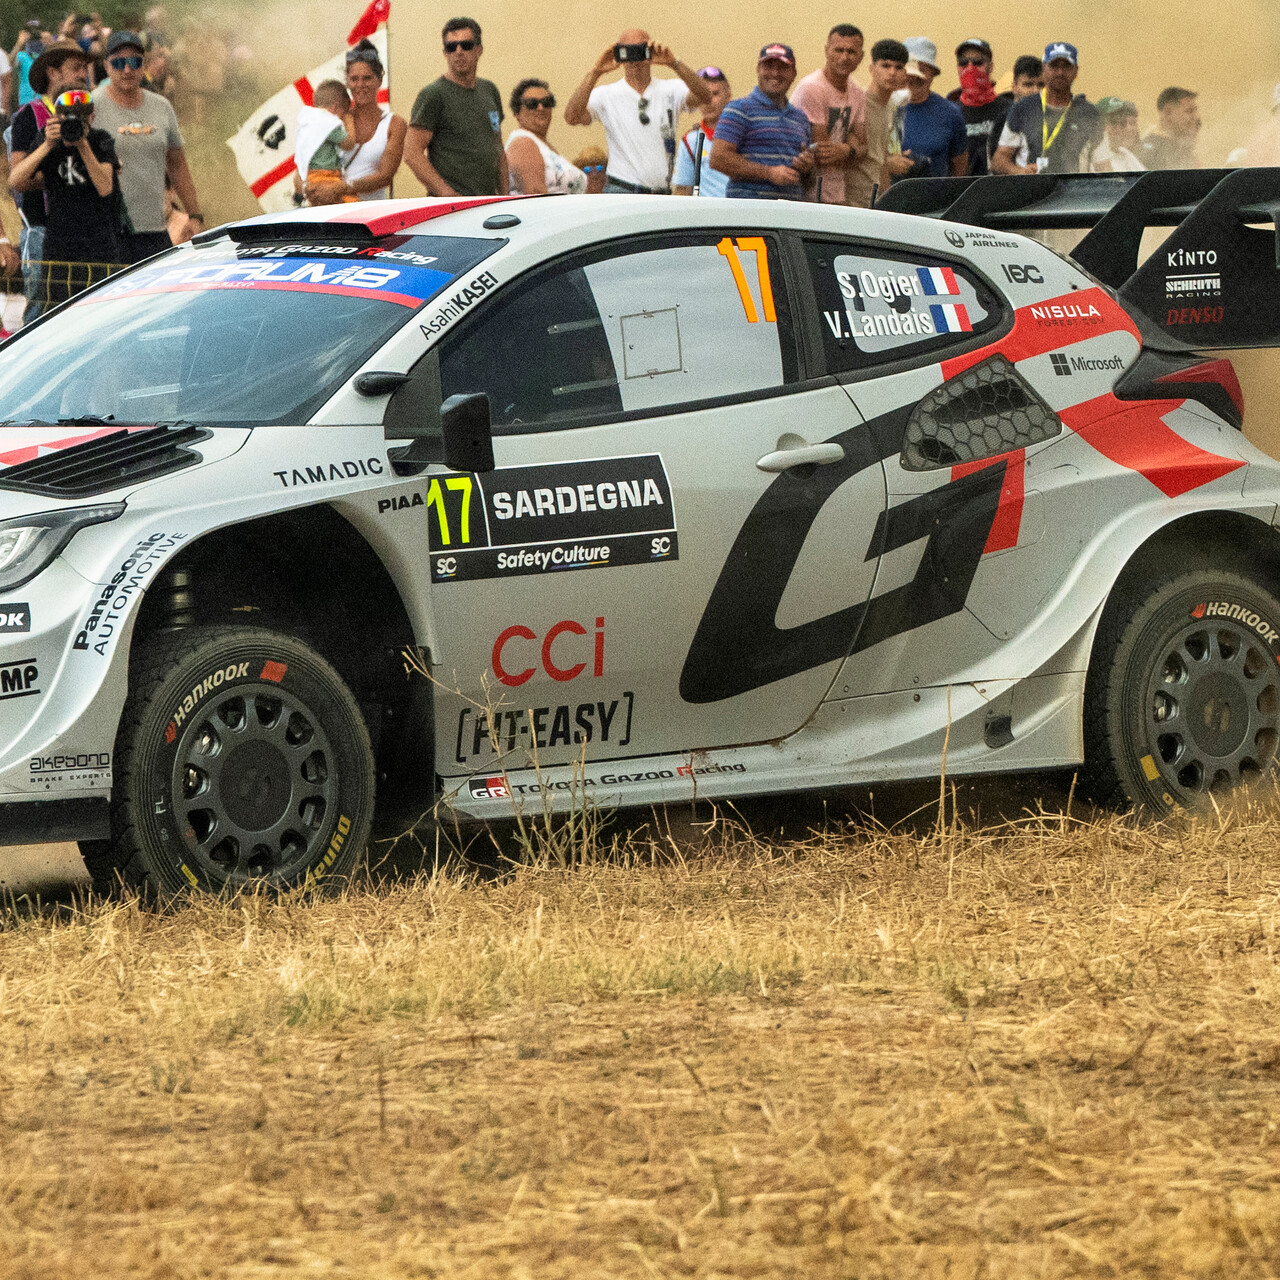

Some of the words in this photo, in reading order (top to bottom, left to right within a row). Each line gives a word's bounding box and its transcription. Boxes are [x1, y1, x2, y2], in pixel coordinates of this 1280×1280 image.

[274, 244, 359, 255] GAZOO
[356, 247, 439, 265] Racing
[973, 240, 1019, 248] AIRLINES
[145, 261, 401, 289] FORUM8
[717, 236, 778, 324] 17
[836, 270, 920, 303] S.Ogier
[1165, 278, 1221, 292] SCHROTH
[1166, 291, 1221, 299] RACING
[823, 306, 935, 339] V.Landais
[1030, 304, 1101, 320] NISULA
[1166, 306, 1224, 326] DENSO
[1070, 354, 1126, 371] Microsoft
[273, 457, 384, 488] TAMADIC
[377, 492, 424, 514] PIAA
[426, 476, 473, 546] 17
[492, 477, 664, 521] SARDEGNA
[496, 544, 611, 570] SafetyCulture
[650, 536, 672, 555] SC
[436, 557, 457, 574] SC
[71, 532, 166, 651] Panasonic
[93, 532, 189, 656] AUTOMOTIVE
[512, 778, 596, 794] TOYOTA
[600, 769, 675, 786] GAZOO
[676, 762, 747, 778] Racing
